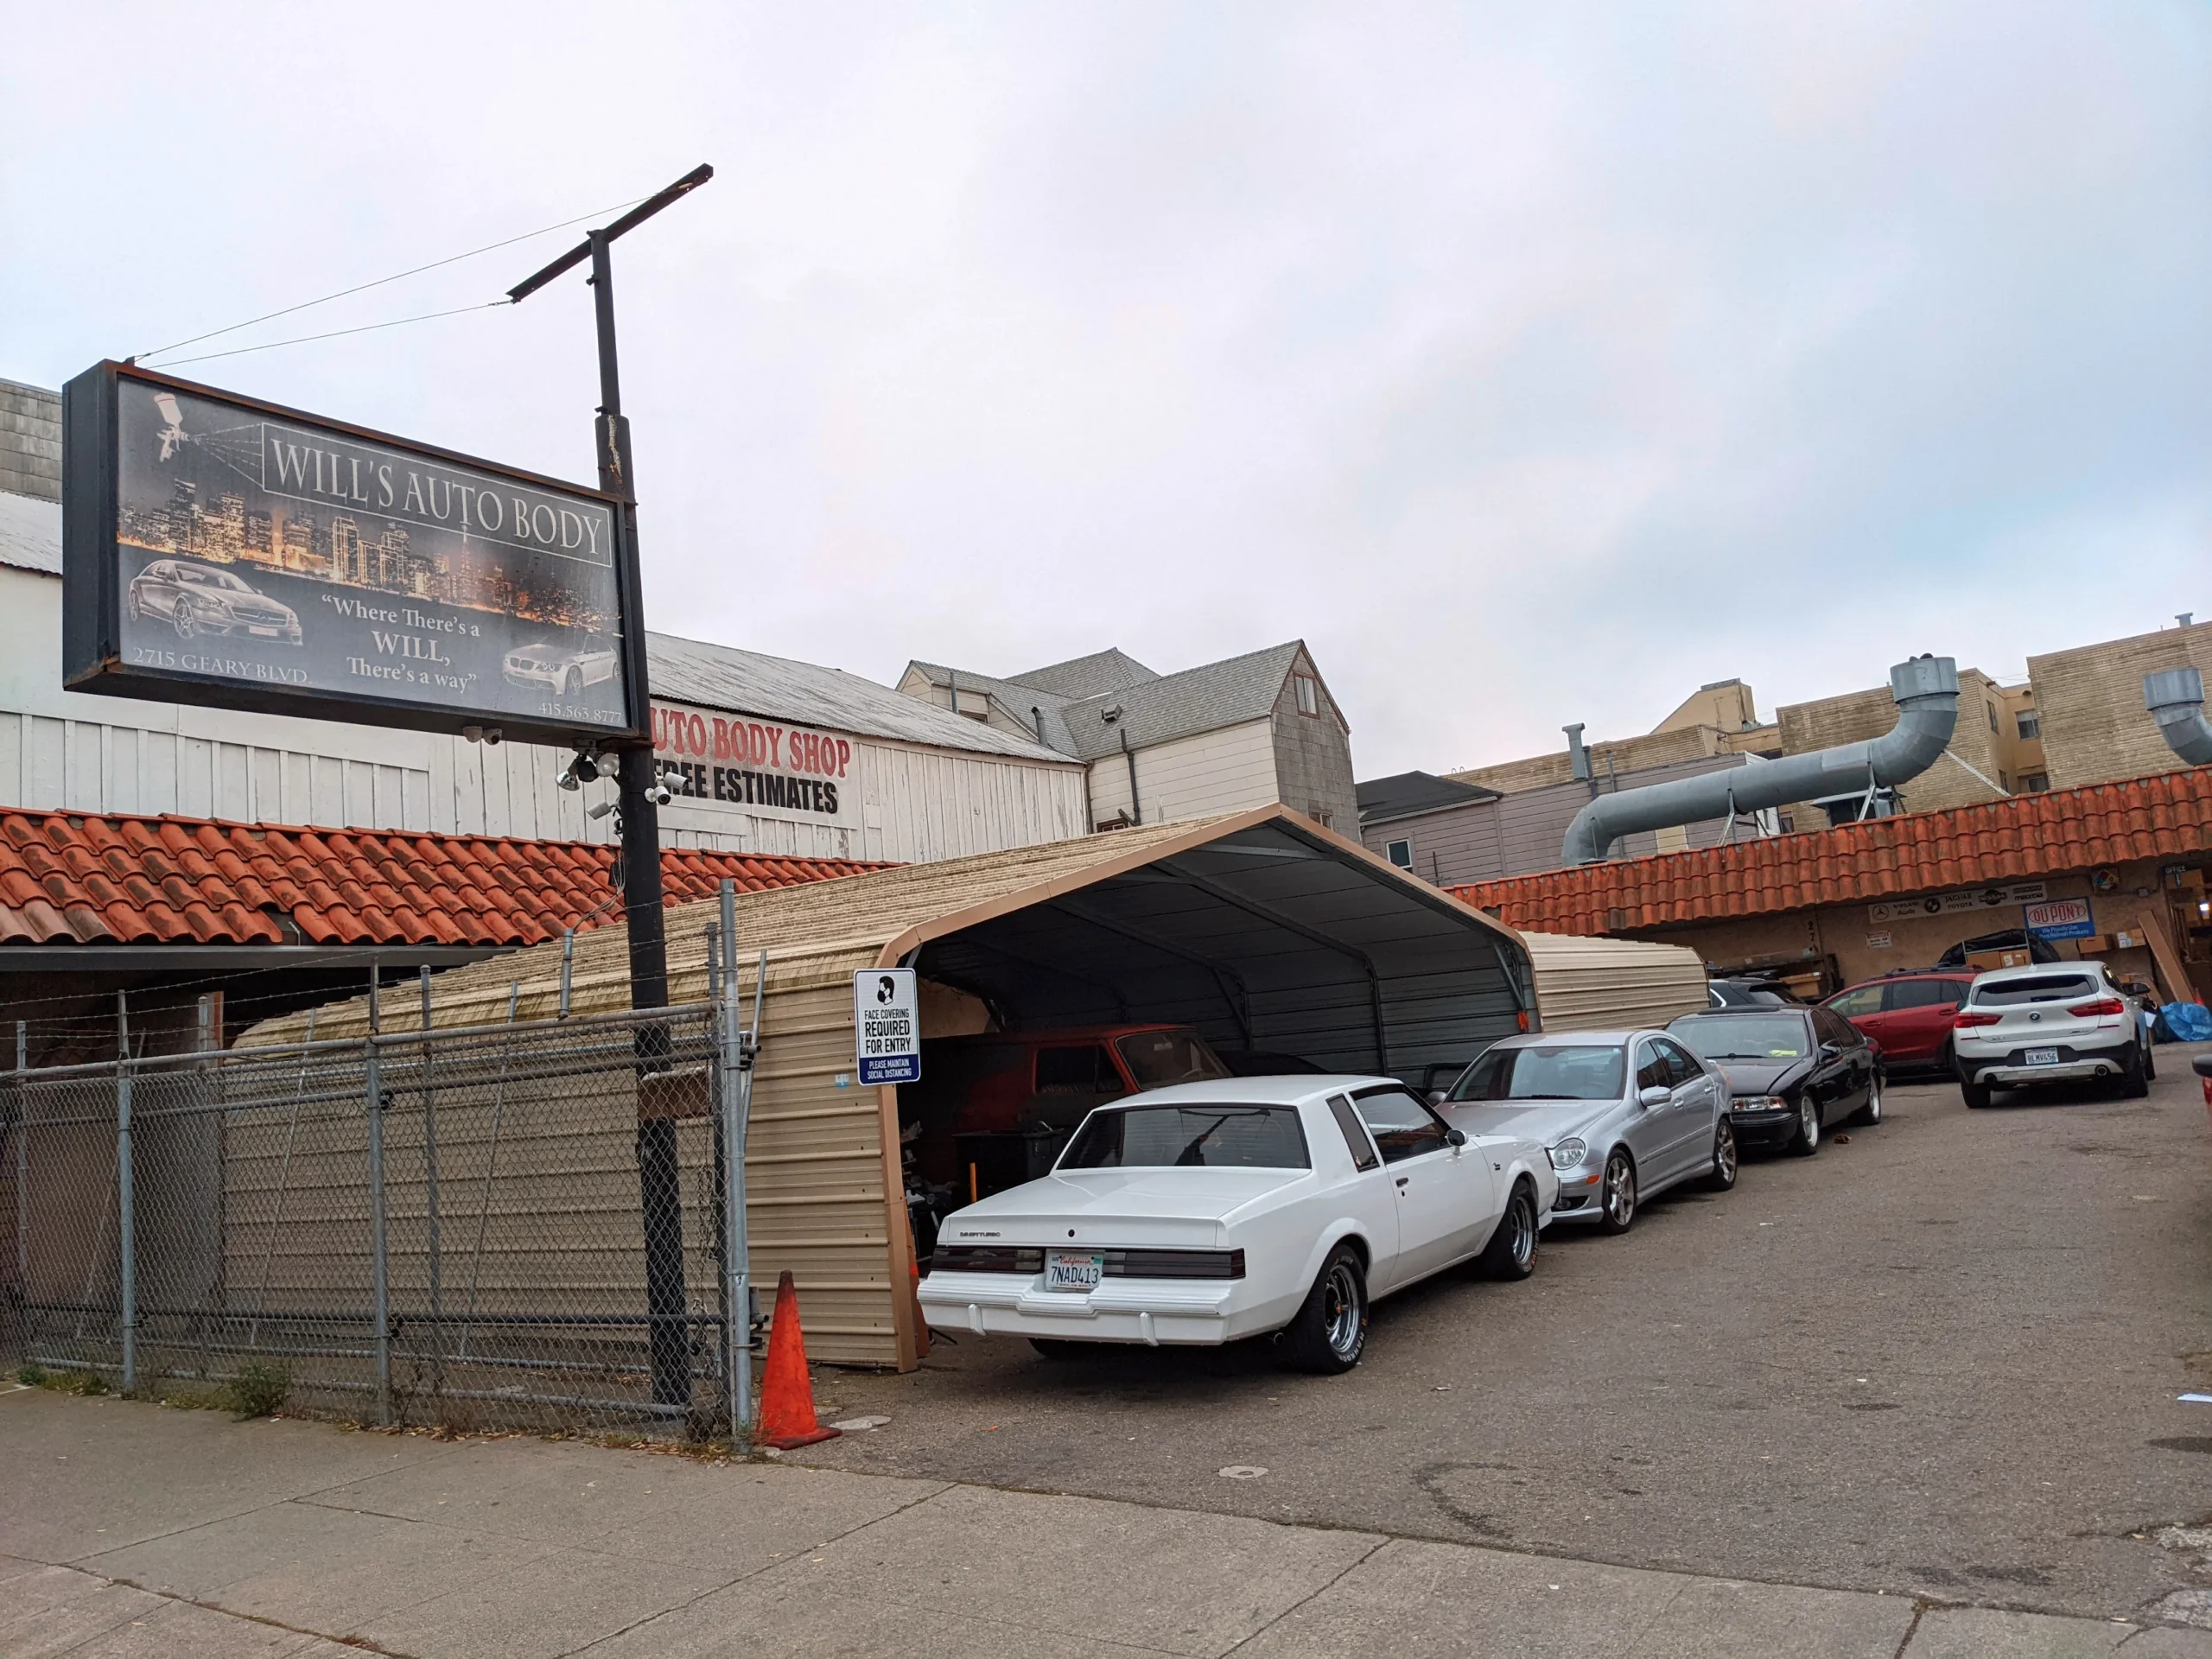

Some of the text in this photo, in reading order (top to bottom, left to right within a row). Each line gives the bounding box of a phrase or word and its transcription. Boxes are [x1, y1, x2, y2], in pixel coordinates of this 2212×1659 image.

[270, 438, 602, 555] WILL'S AUTO BODY
[401, 608, 467, 635] There’s
[470, 625, 480, 637] a
[371, 630, 450, 666] WILL,
[133, 647, 313, 684] 2715 GEARY BLVD.
[346, 657, 415, 682] There’s
[419, 672, 430, 684] a
[538, 702, 622, 723] 415.563.8777
[650, 706, 850, 778] UTO BODY SHOP
[713, 766, 838, 814] ESTIMATES
[2165, 865, 2186, 874] OFFICE
[1945, 893, 1972, 903] JAGUAR
[1948, 901, 1974, 910] TOYOTA
[864, 1007, 910, 1020] FACE COVERING
[865, 1020, 910, 1038] REQUIRED
[866, 1037, 911, 1054] FOR ENTRY
[869, 1058, 910, 1070] PLEASE MAINTAIN
[868, 1068, 912, 1080] SOCIAL DISTANCING
[1059, 1255, 1091, 1266] California
[1052, 1266, 1099, 1284] 7NAD413
